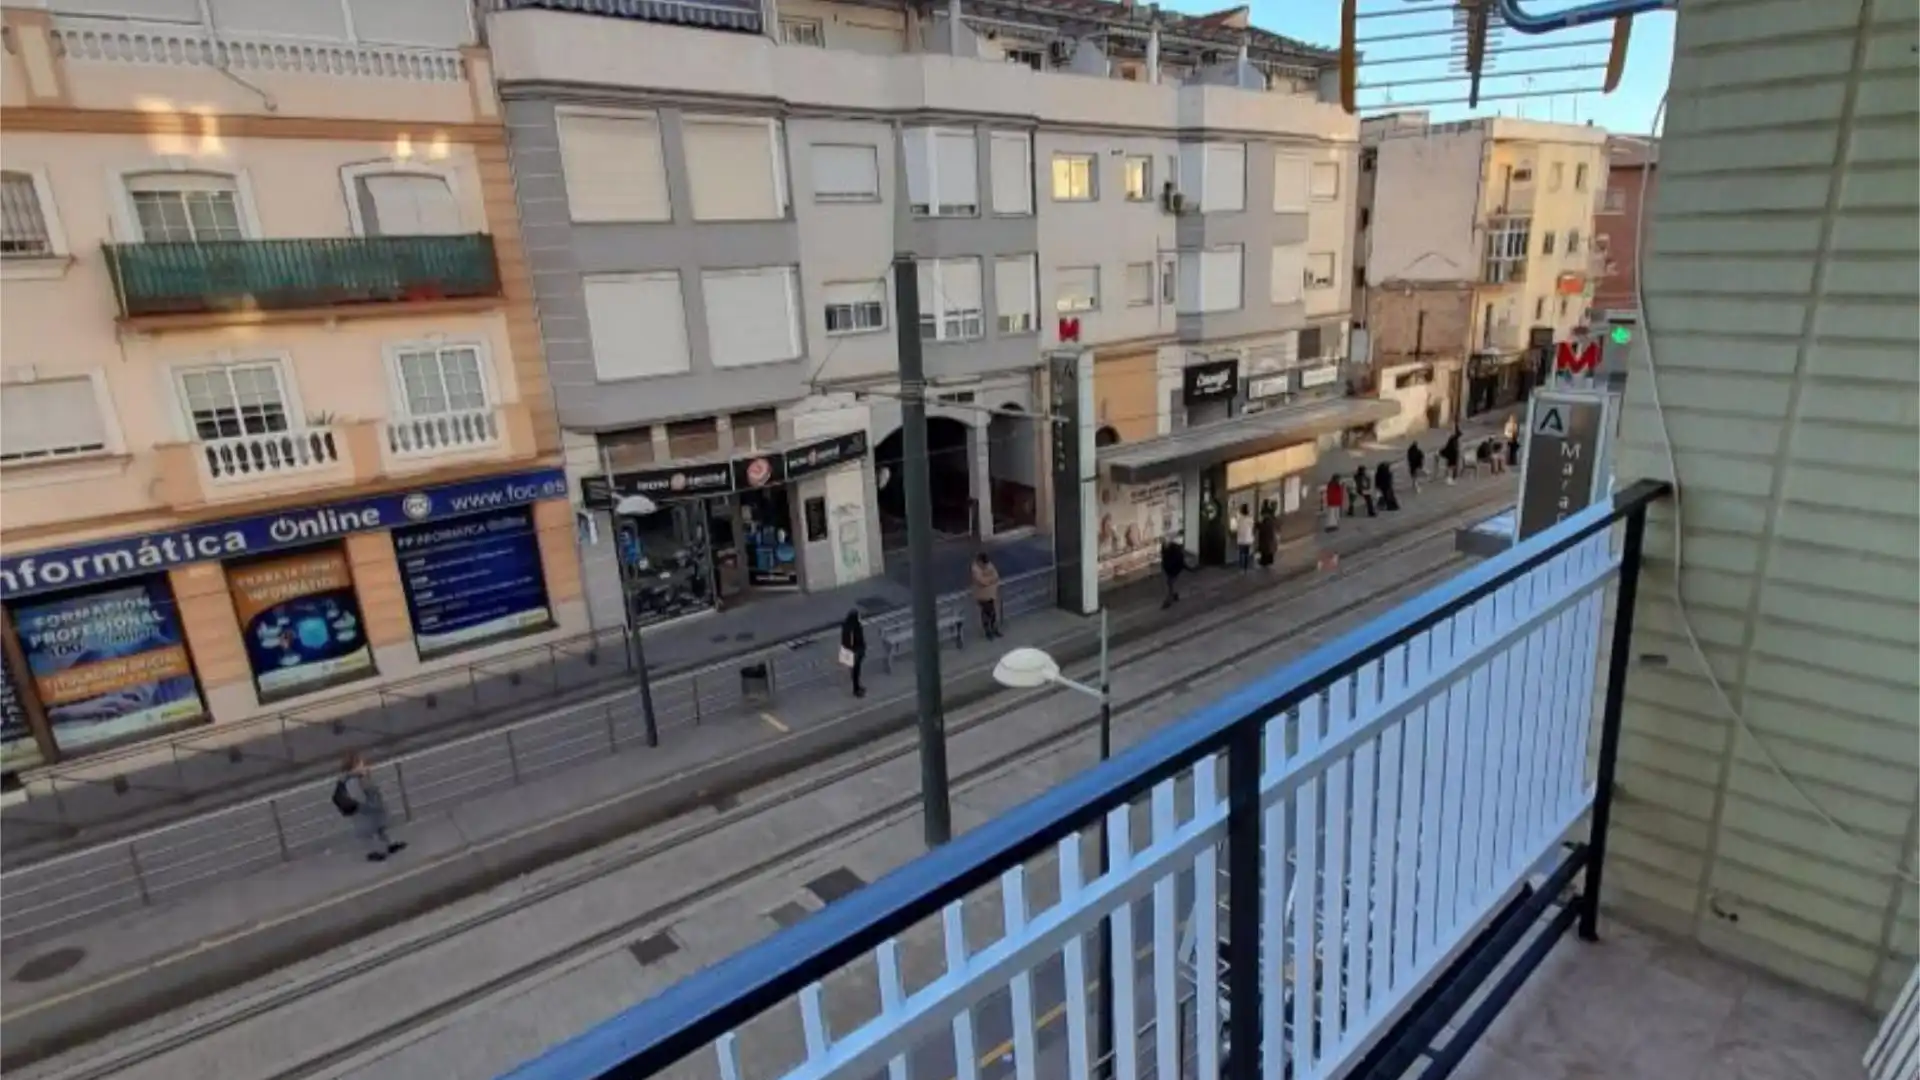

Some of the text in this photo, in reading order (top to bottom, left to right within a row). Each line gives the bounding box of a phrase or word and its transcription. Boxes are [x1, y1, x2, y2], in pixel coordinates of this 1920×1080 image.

[450, 479, 565, 512] www.foc.es
[0, 530, 247, 593] nformática
[270, 507, 380, 542] Online
